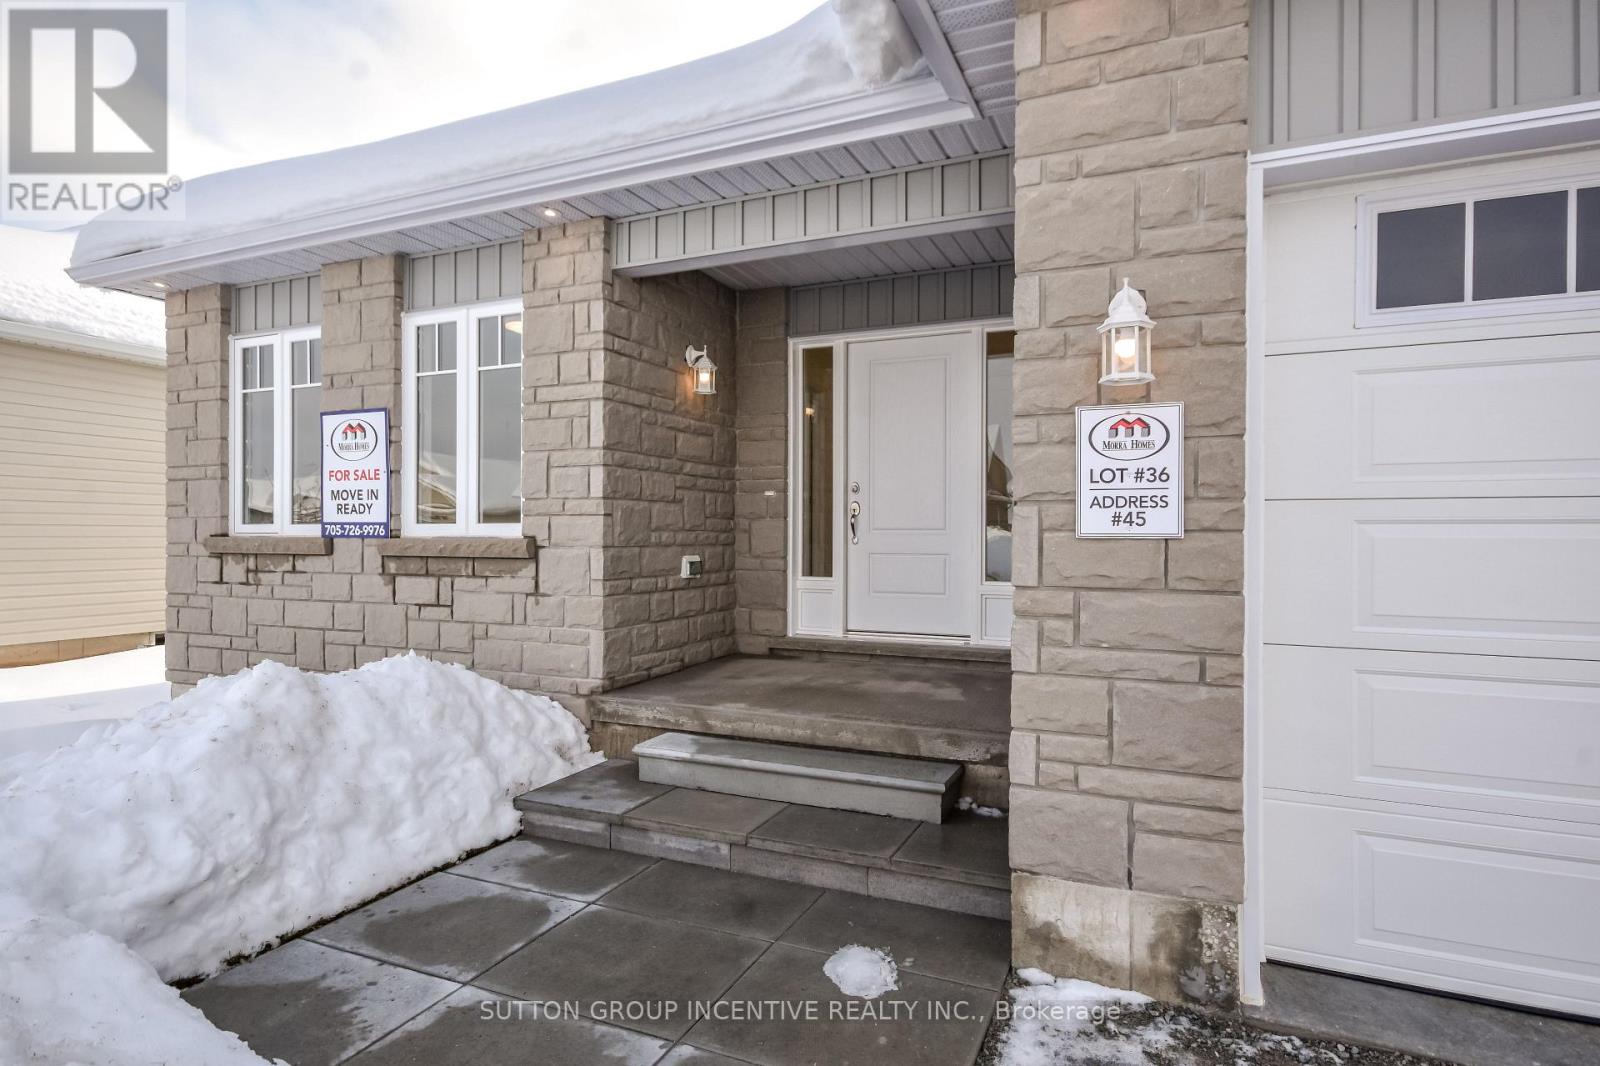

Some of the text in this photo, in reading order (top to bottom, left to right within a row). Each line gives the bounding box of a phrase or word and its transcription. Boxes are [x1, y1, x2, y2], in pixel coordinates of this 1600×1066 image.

[328, 469, 381, 482] FOR SALE
[1089, 467, 1170, 484] LOT #36
[330, 489, 379, 501] MOVE IN
[1089, 495, 1169, 509] ADDRESS
[336, 503, 373, 515] READY
[1111, 511, 1147, 527] #45
[324, 524, 386, 536] 705-726-9976
